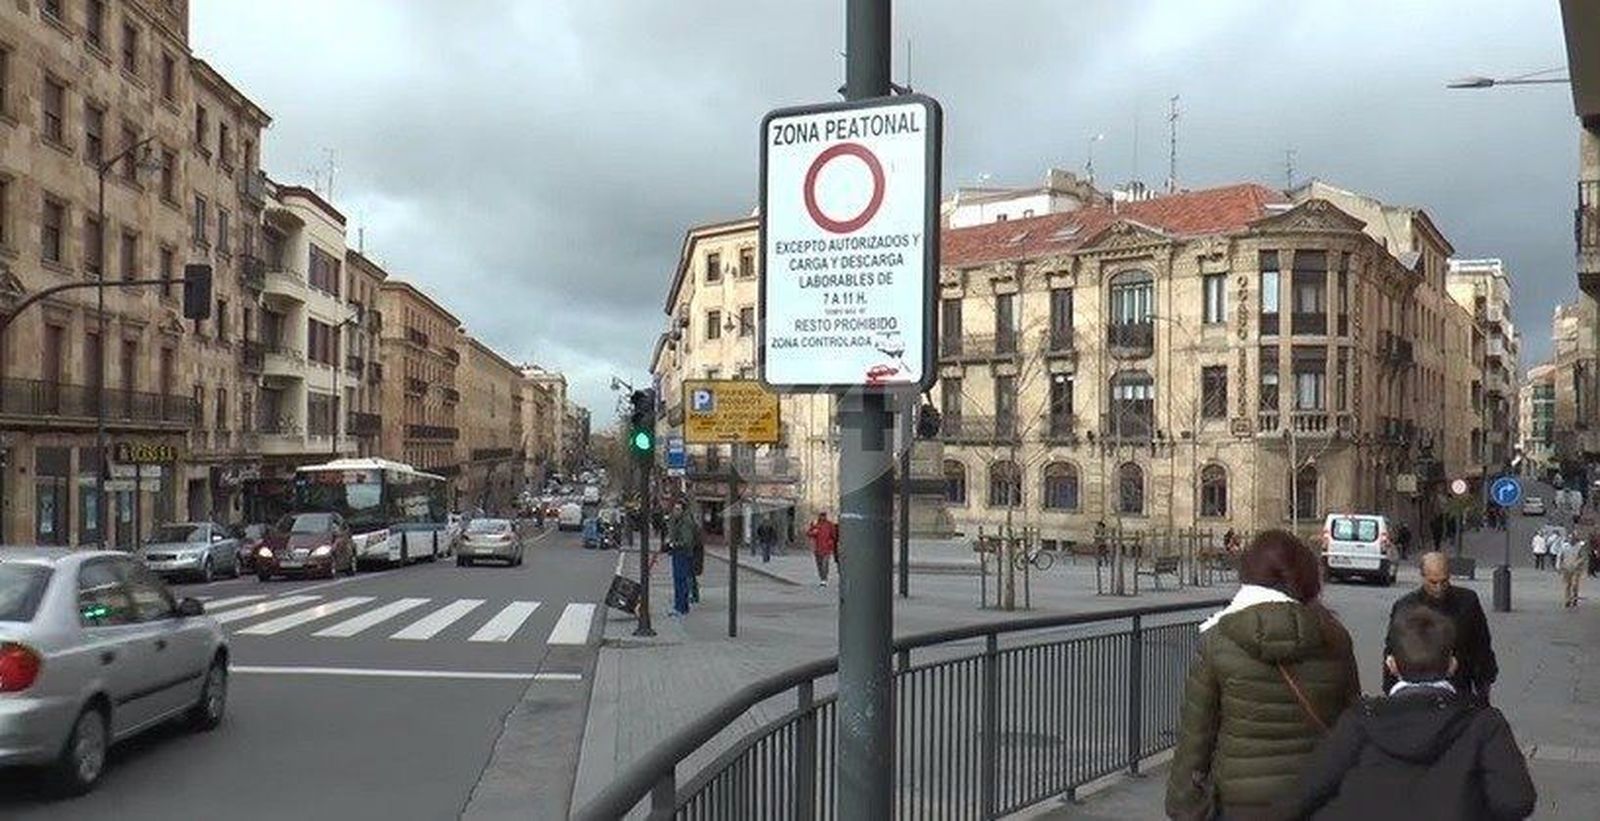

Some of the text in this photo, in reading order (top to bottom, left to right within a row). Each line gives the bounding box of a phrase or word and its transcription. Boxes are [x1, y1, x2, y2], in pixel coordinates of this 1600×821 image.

[773, 112, 920, 146] ZONA PEATONAL
[775, 234, 921, 254] EXCEPTO AUTORIZADOS Y
[789, 253, 904, 271] CARGA Y DESCARGA
[800, 272, 893, 288] LABORABLES DE
[823, 292, 830, 304] 7
[832, 292, 840, 304] A
[843, 292, 853, 304] 11
[794, 317, 897, 332] RESTO PROHIBIDO
[771, 336, 872, 349] ZONA CONTROLADA
